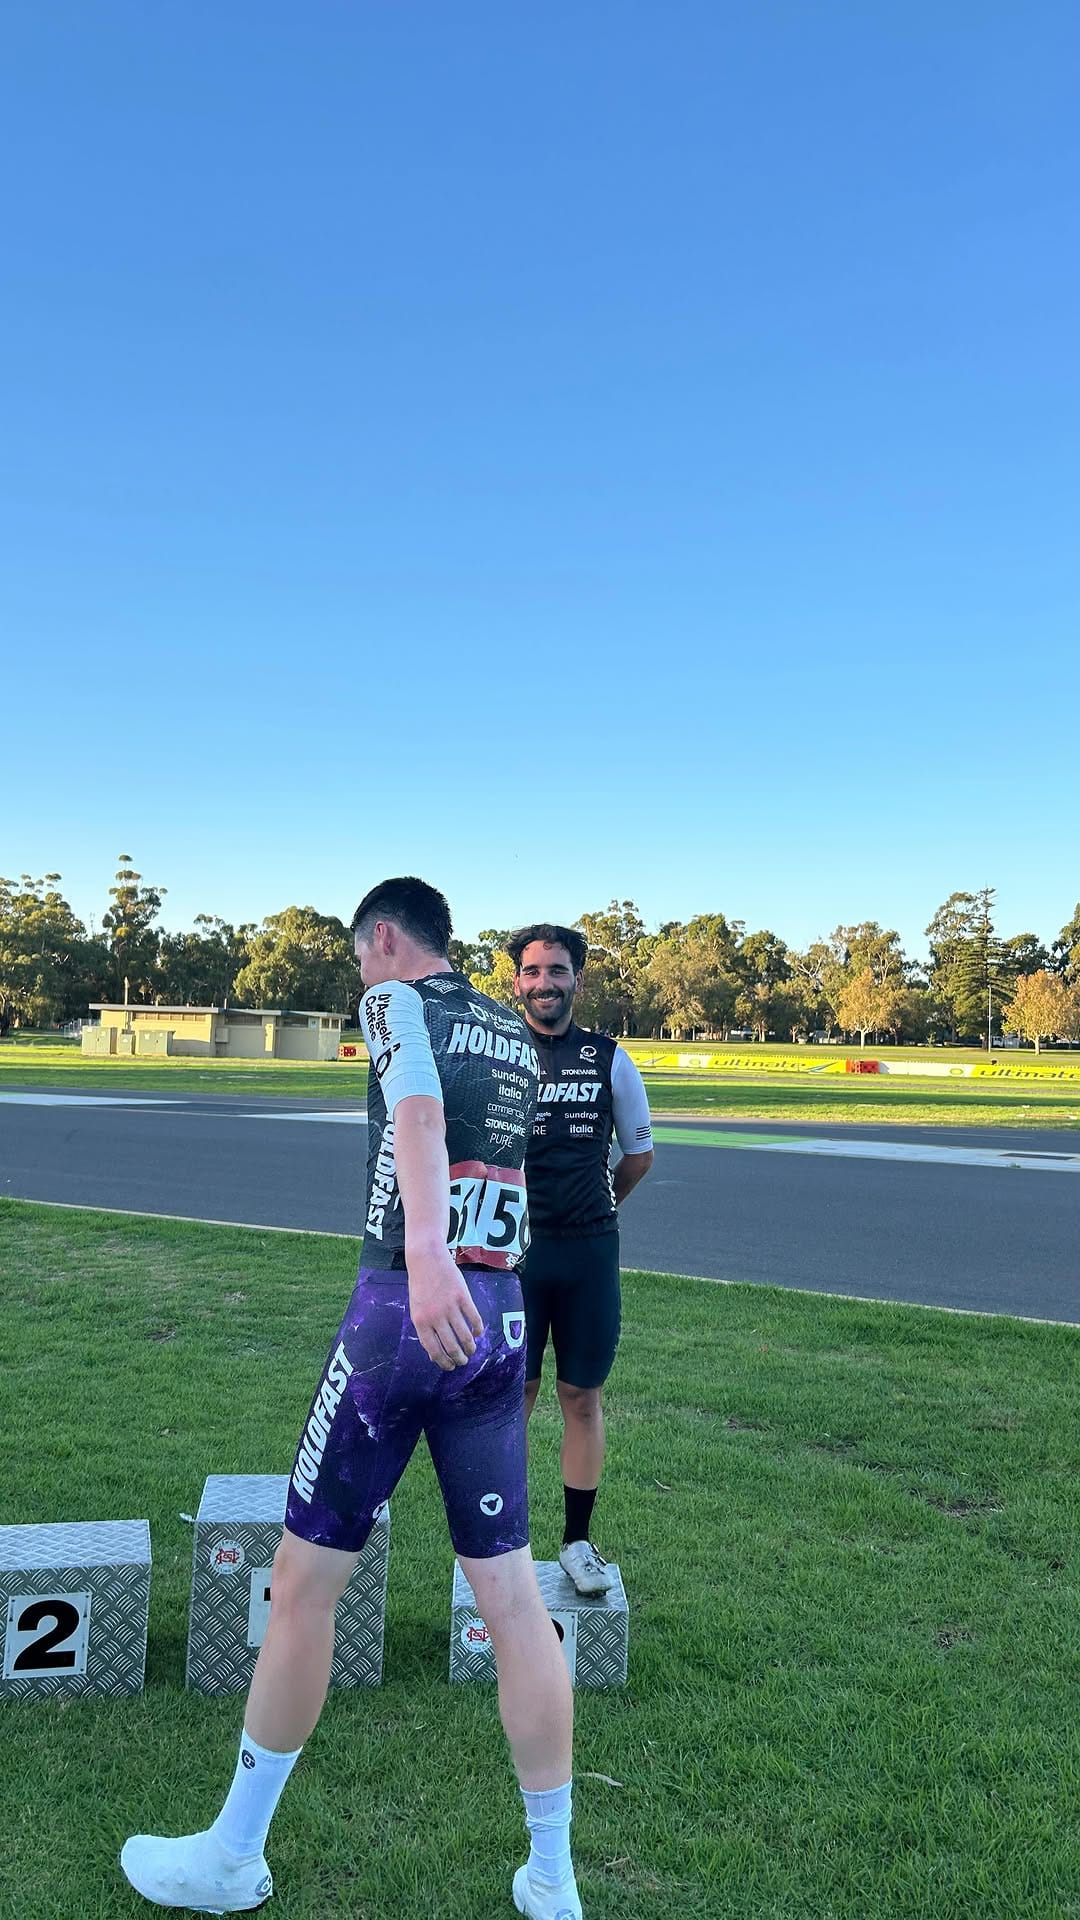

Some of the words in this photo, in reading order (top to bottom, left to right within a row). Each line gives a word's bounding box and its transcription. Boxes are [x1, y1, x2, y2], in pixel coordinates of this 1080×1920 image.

[365, 995, 377, 1041] Coffee
[447, 1023, 540, 1079] HOLDFAS
[714, 1058, 806, 1069] ultimate
[491, 1068, 529, 1089] sundrop
[498, 1084, 522, 1100] italia
[536, 1082, 602, 1102] LDFAST
[564, 1110, 599, 1121] sundrop
[485, 1118, 526, 1137] STONEWARE
[532, 1125, 547, 1135] RE
[569, 1125, 593, 1133] italia
[489, 1132, 515, 1148] PURE
[365, 1110, 397, 1241] OLDFAST
[292, 1341, 354, 1504] HOLDFAST
[13, 1599, 80, 1671] 2
